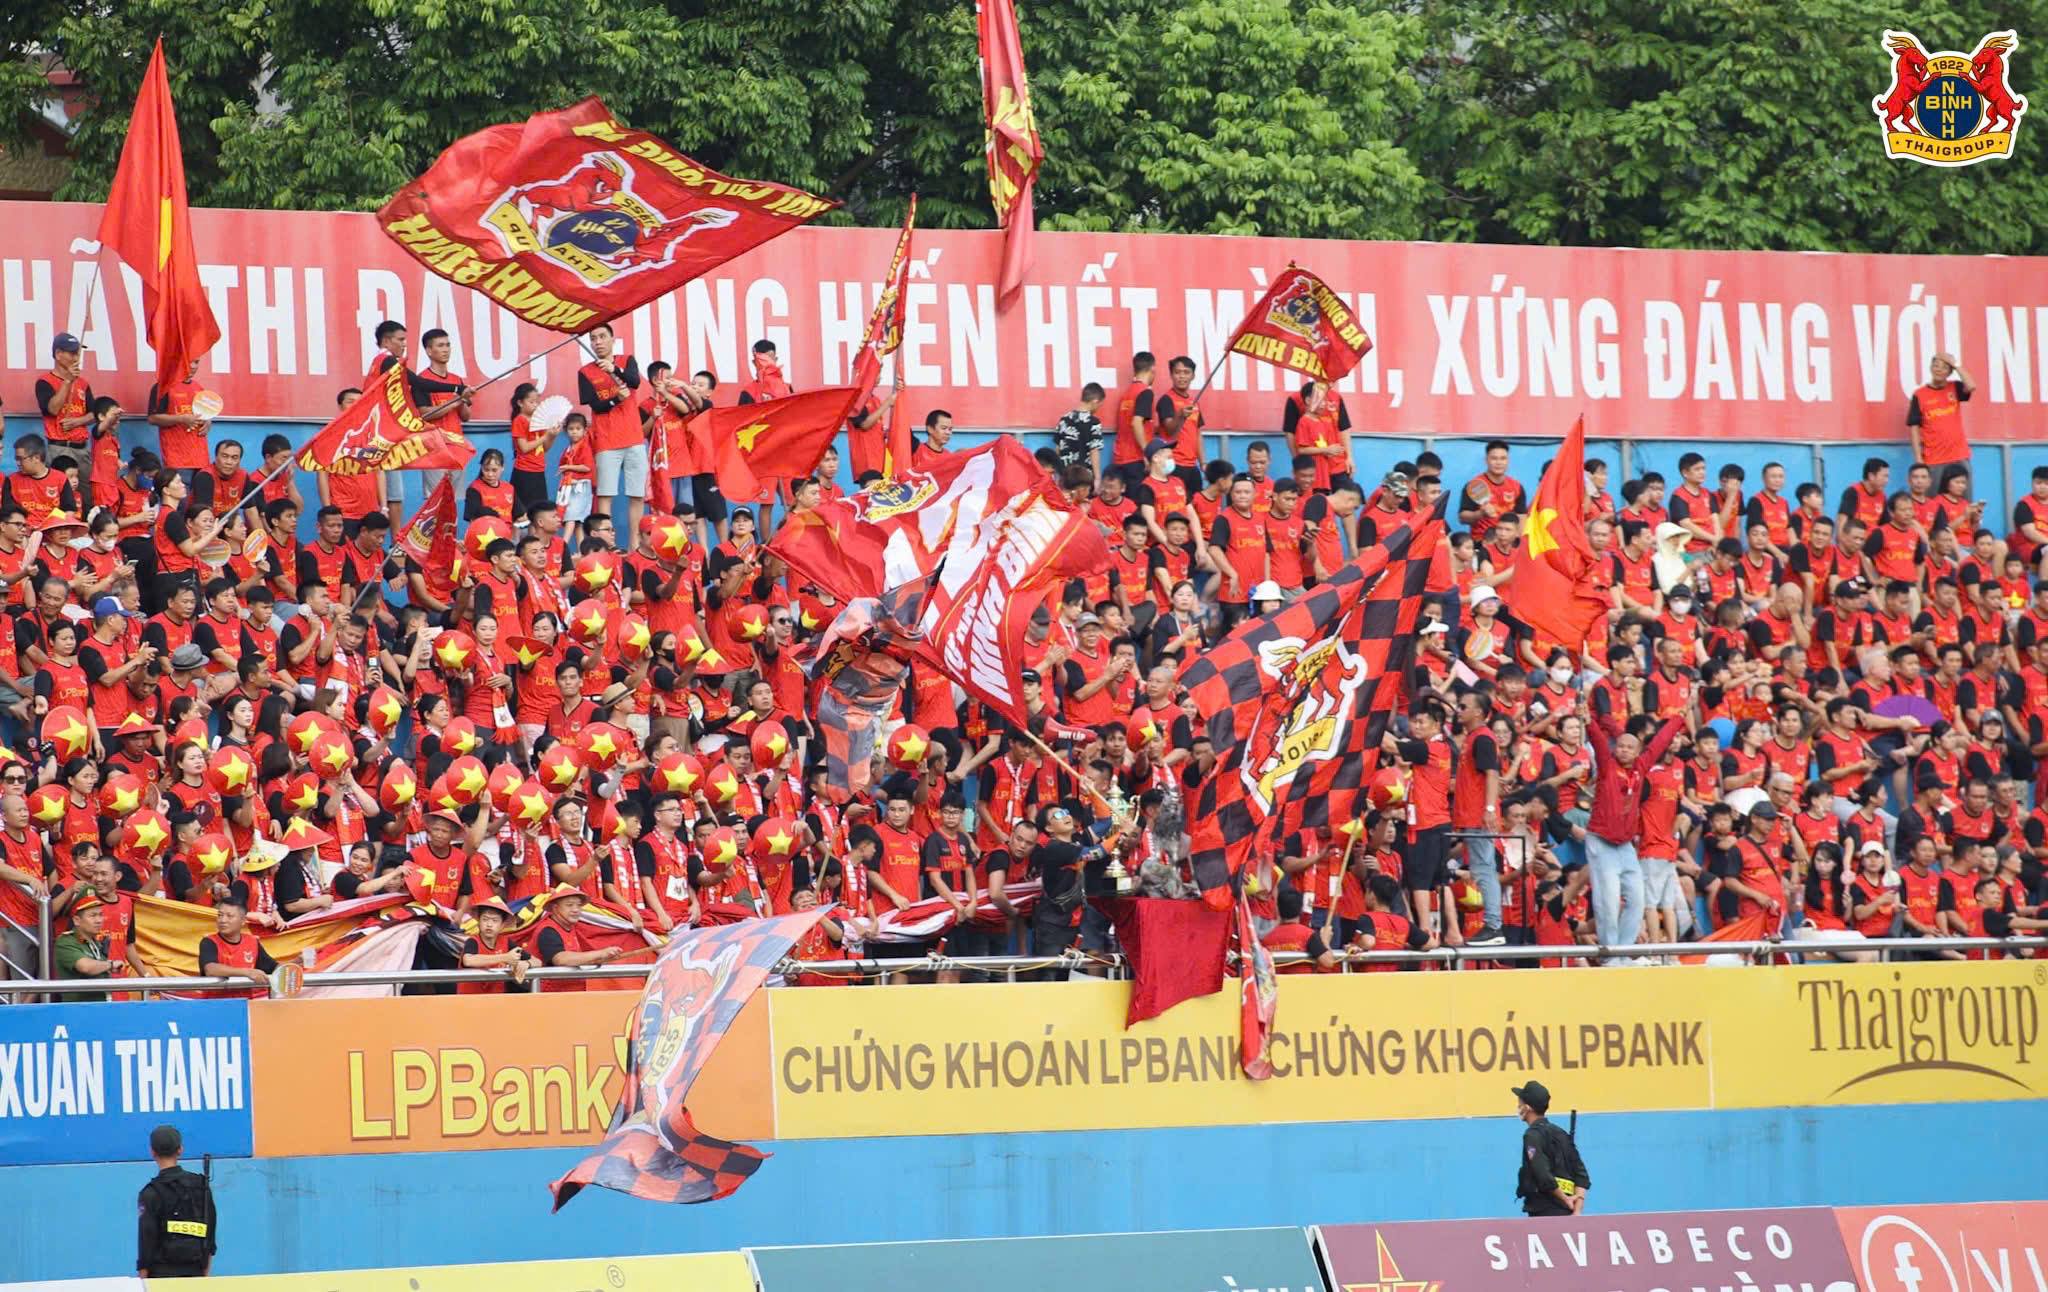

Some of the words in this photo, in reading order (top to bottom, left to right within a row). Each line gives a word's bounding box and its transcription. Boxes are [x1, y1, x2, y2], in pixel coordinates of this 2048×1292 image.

[197, 264, 328, 376] THI
[1024, 251, 1158, 389] HẾT
[1185, 266, 1404, 408] MÌH,
[1427, 273, 1621, 398] XỨNG
[1643, 279, 1833, 402] ĐÁNG
[969, 576, 1014, 706] NINH
[783, 1028, 936, 1095] CHỨNG
[944, 1023, 1090, 1089] KHOÁN
[1269, 1015, 1406, 1078] CHỨNG
[1414, 1010, 1551, 1074] KHOÁN
[1559, 1020, 1705, 1070] LPBANK
[1797, 970, 2039, 1064] Thaigroup
[0, 1024, 105, 1118] XUÂN
[115, 1021, 244, 1113] THÀNH
[348, 1044, 616, 1141] LPBank
[1483, 1223, 1795, 1271] SAVABECO
